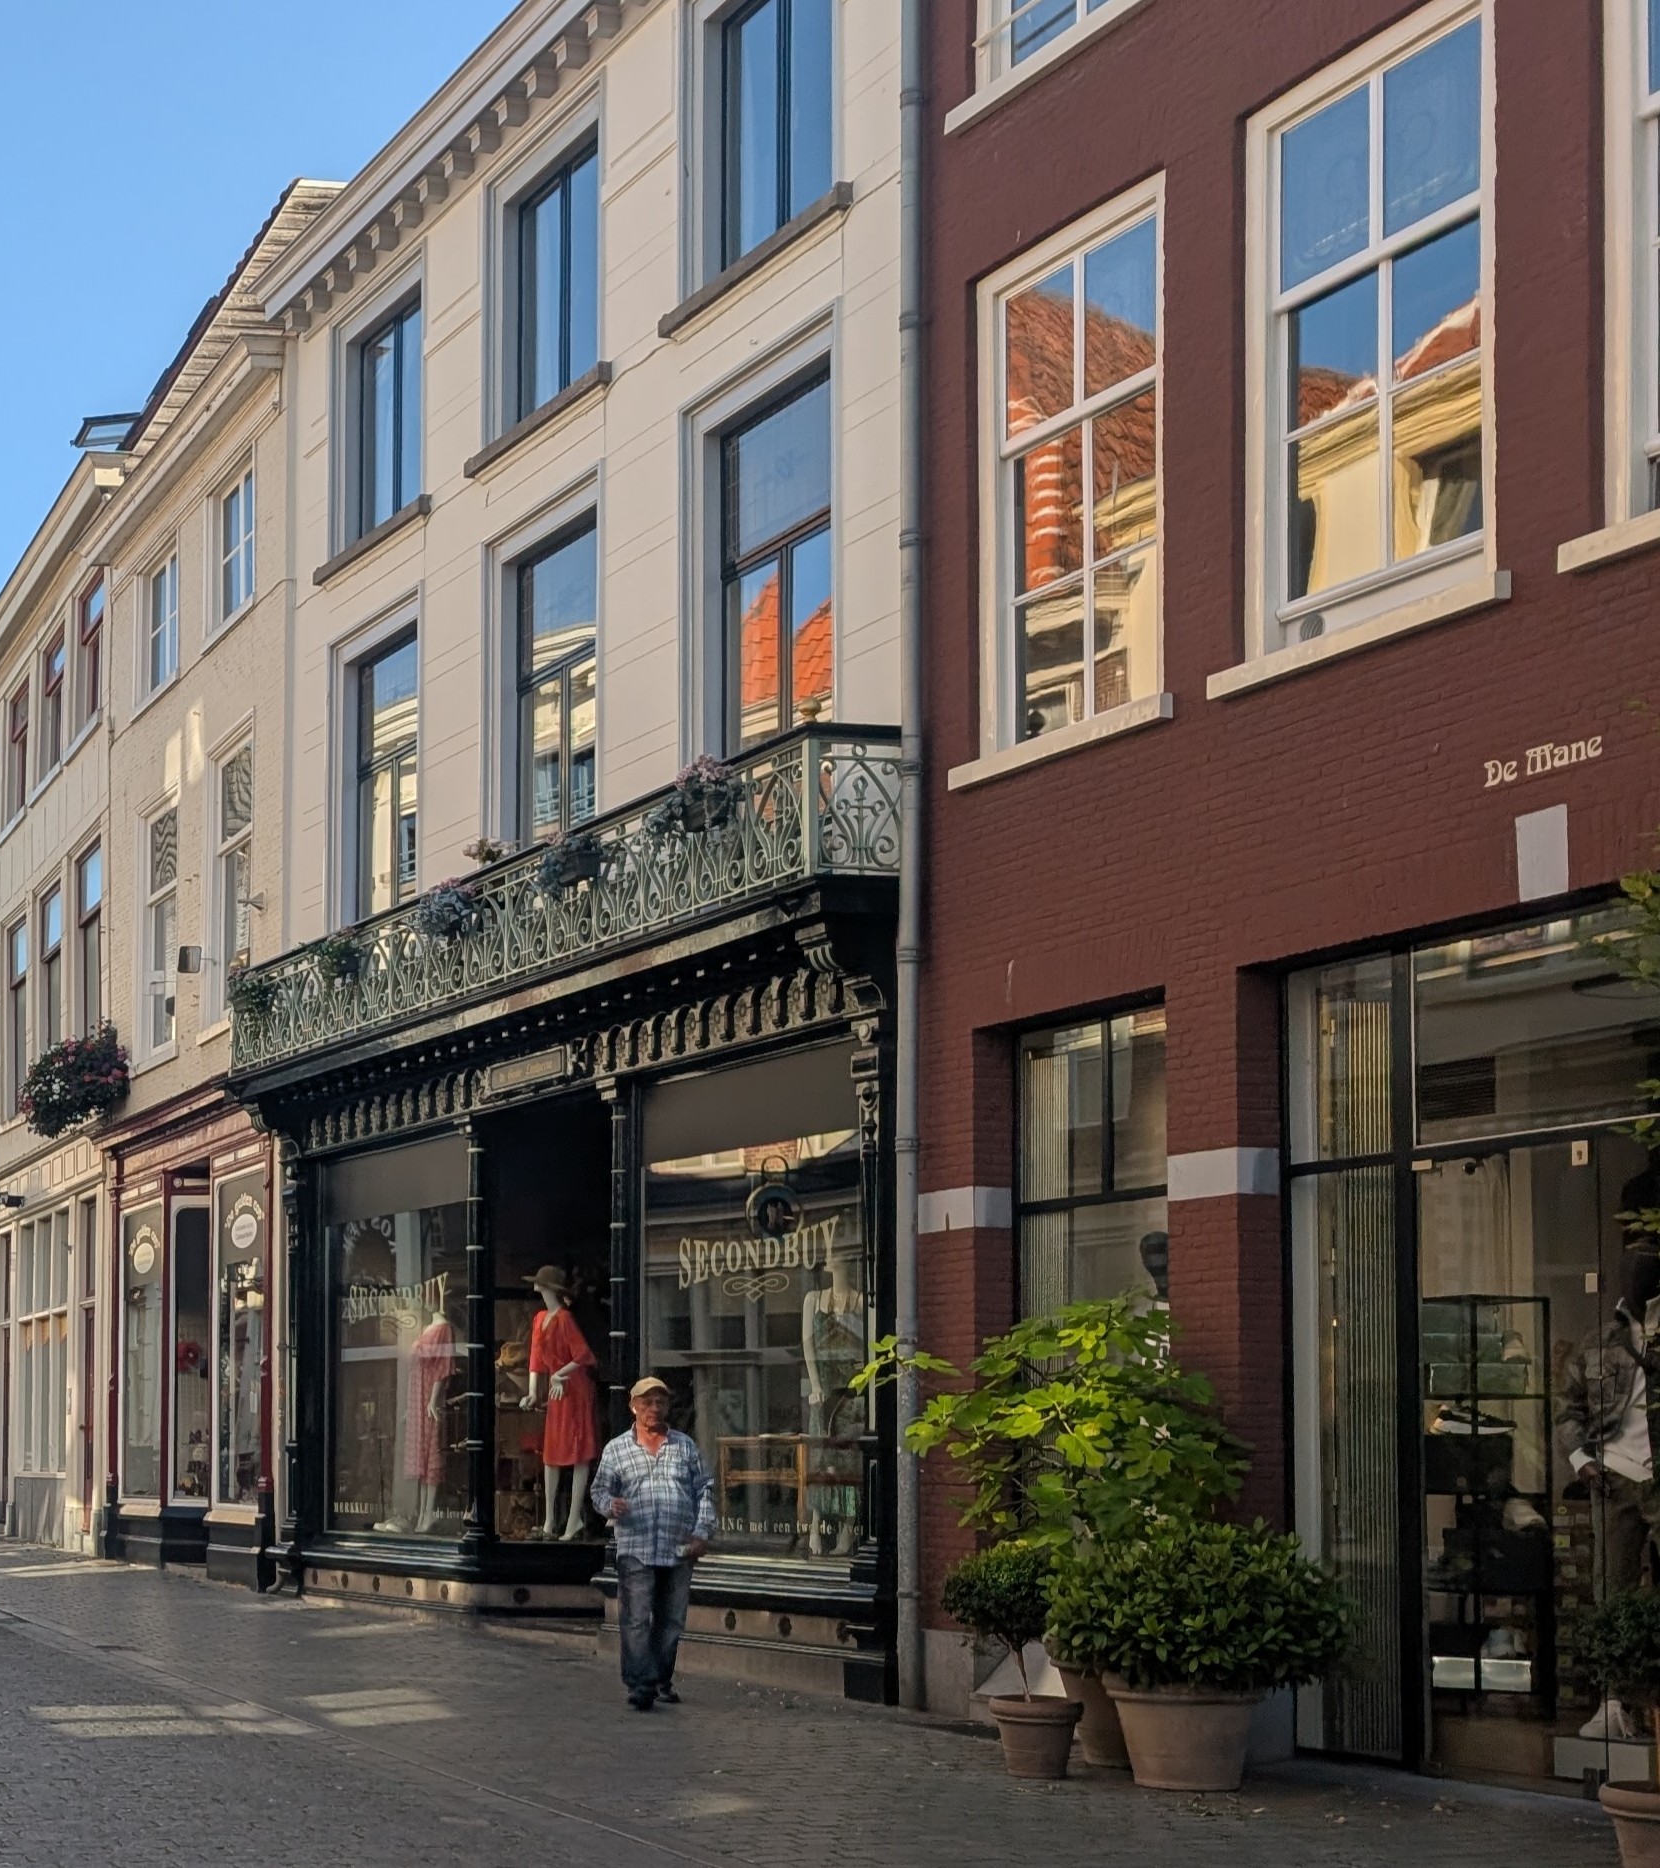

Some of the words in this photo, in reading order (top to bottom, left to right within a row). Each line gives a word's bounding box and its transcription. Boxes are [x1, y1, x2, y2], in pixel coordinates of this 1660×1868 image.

[1483, 759, 1518, 788] De
[1525, 735, 1603, 776] Mane
[678, 1214, 840, 1291] SECONDBUY
[348, 1270, 449, 1325] SECONDBUY
[749, 1519, 768, 1533] met
[773, 1521, 791, 1533] een
